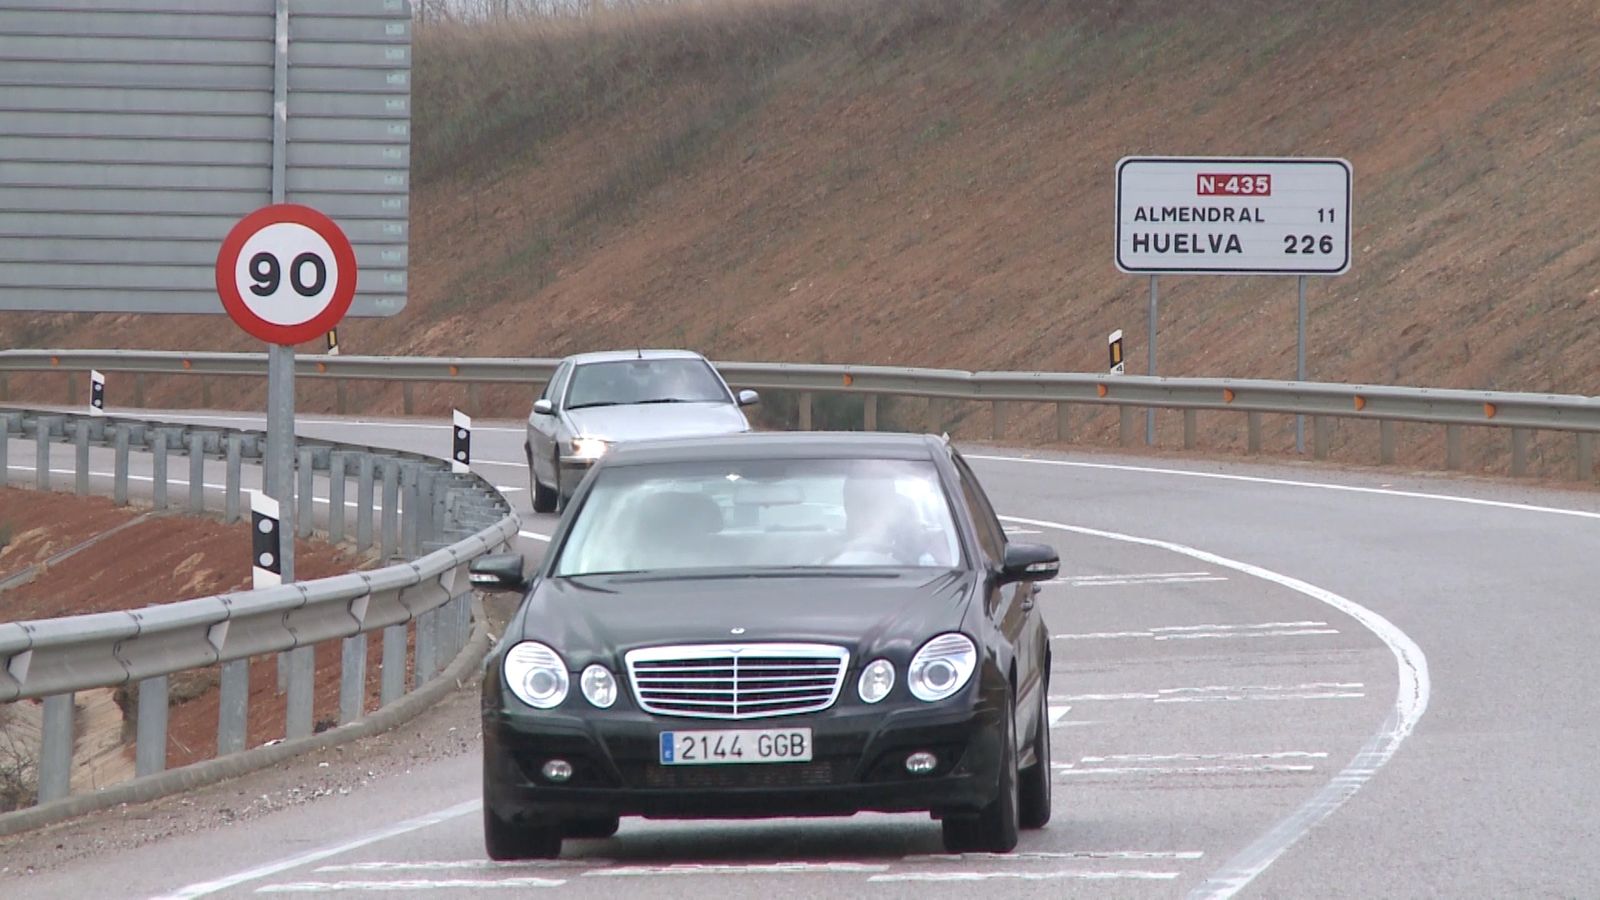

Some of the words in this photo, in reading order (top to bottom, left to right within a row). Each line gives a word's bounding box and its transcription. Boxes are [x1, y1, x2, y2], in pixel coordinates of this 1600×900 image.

[1199, 176, 1268, 194] N-435
[1134, 206, 1265, 223] ALMENDRAL
[1318, 208, 1335, 223] 11
[1132, 233, 1243, 254] HUELVA
[1283, 235, 1333, 254] 226
[249, 251, 327, 297] 90
[681, 735, 743, 760] 2144
[758, 733, 805, 757] GGB
